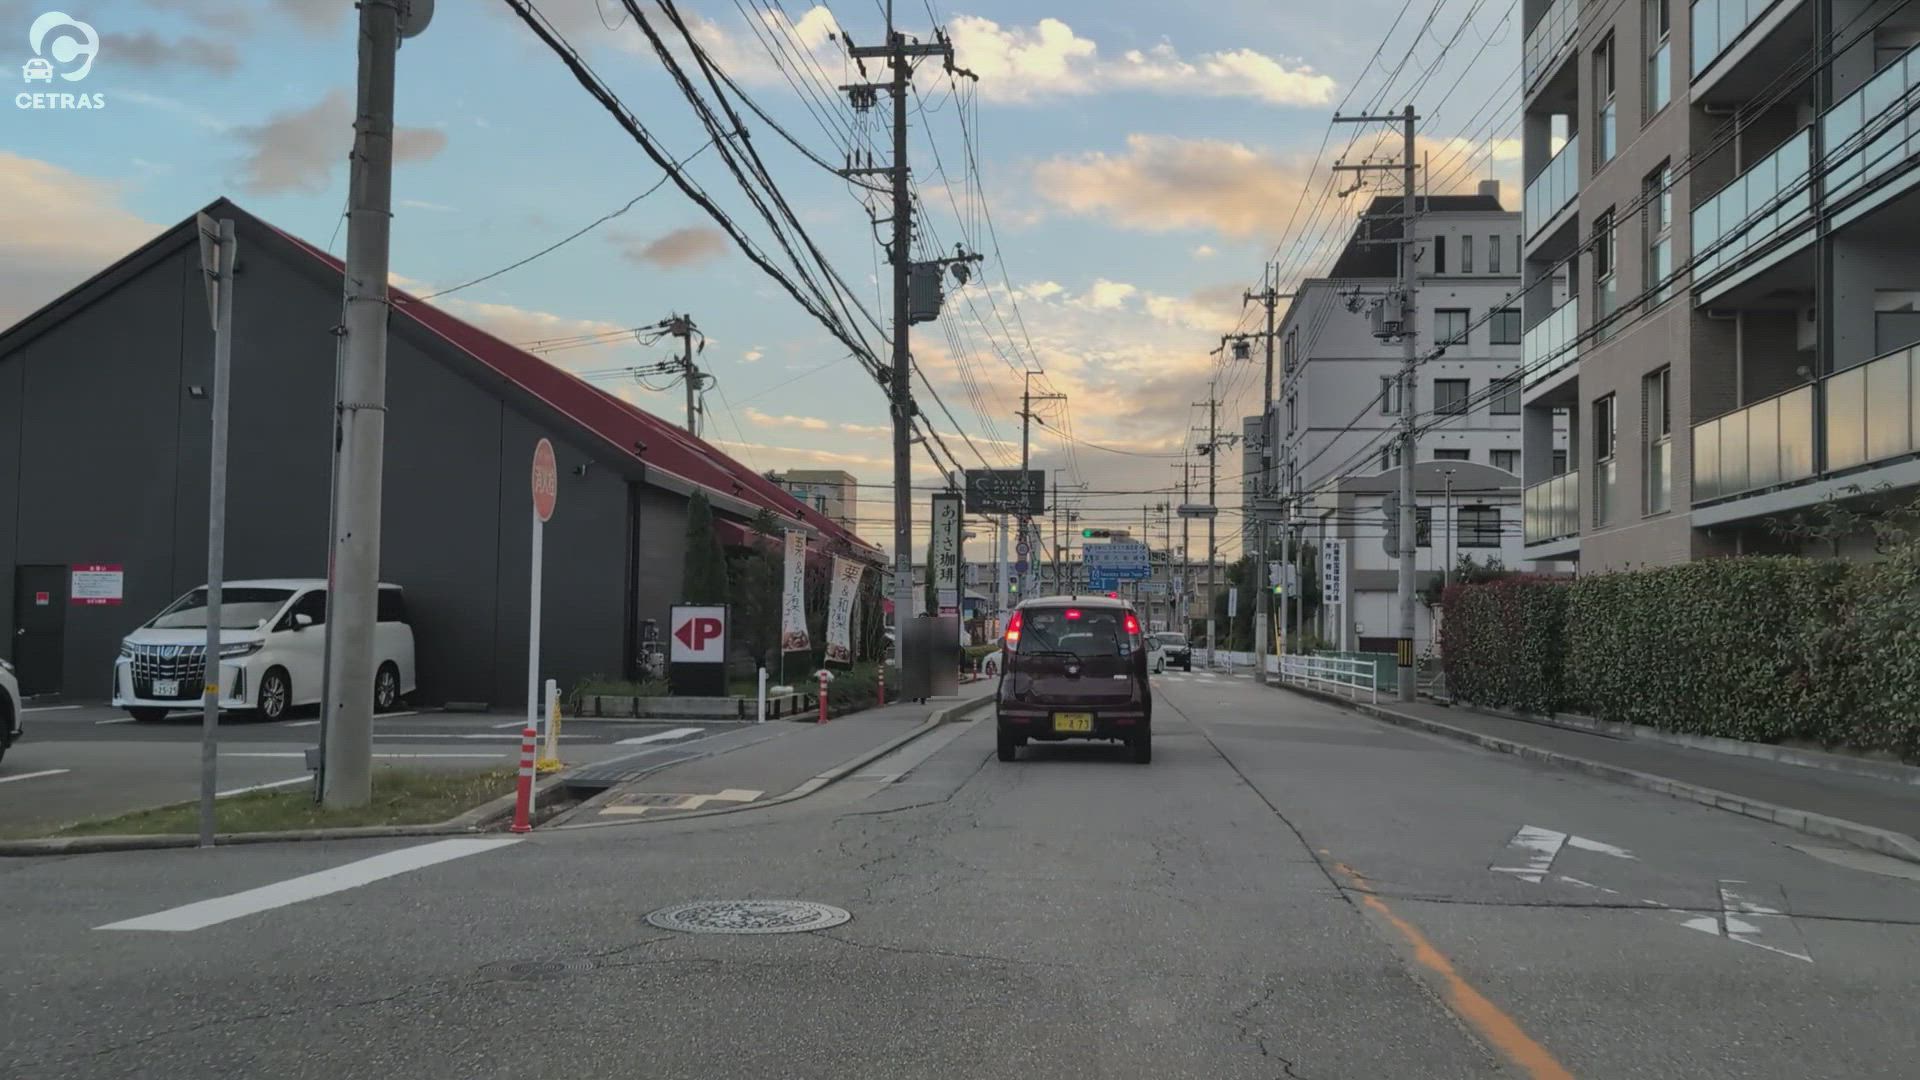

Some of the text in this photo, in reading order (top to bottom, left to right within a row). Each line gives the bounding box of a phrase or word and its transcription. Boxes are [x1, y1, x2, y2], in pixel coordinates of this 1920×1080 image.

[940, 504, 957, 584] あずさ珈琲
[694, 617, 722, 651] P
